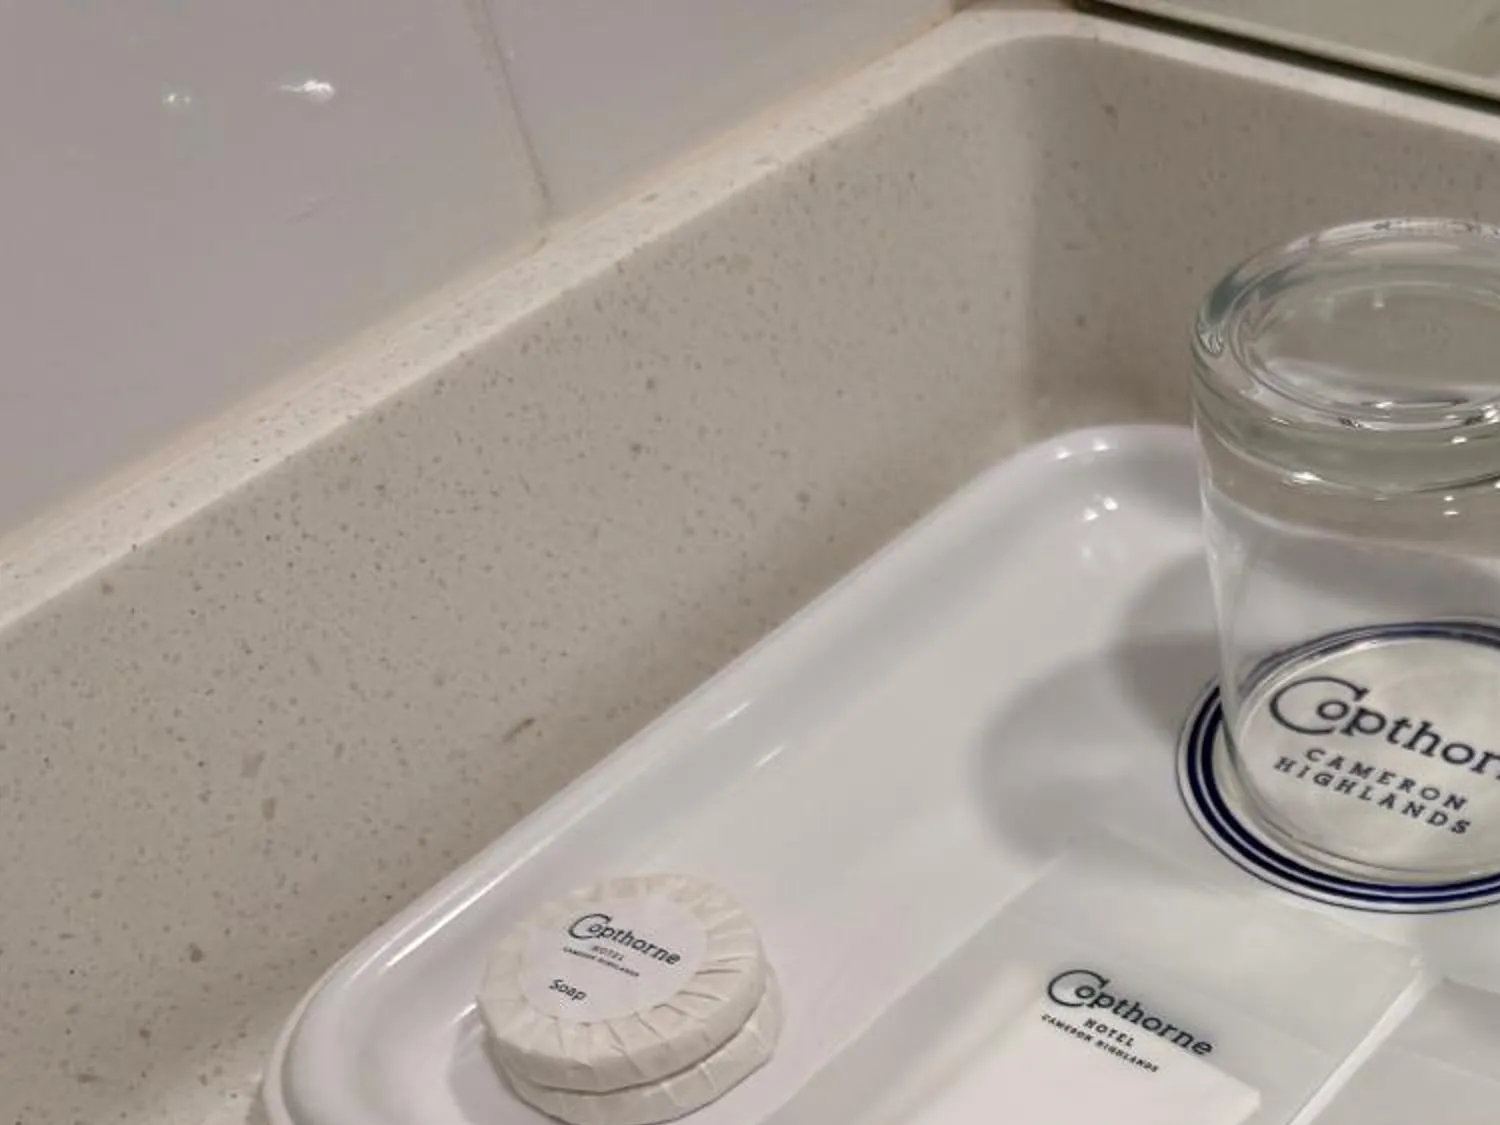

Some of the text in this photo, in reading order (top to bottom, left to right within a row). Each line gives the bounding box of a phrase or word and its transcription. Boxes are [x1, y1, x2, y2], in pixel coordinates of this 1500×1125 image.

[1273, 755, 1473, 836] HIGHLANDS
[1303, 747, 1469, 812] CAMERON
[568, 913, 681, 965] Copthorne
[548, 979, 588, 1001] Soap
[1047, 969, 1214, 1056] Copthorne
[1040, 1012, 1094, 1043] CAMERON
[1083, 1017, 1136, 1048] HOTEL
